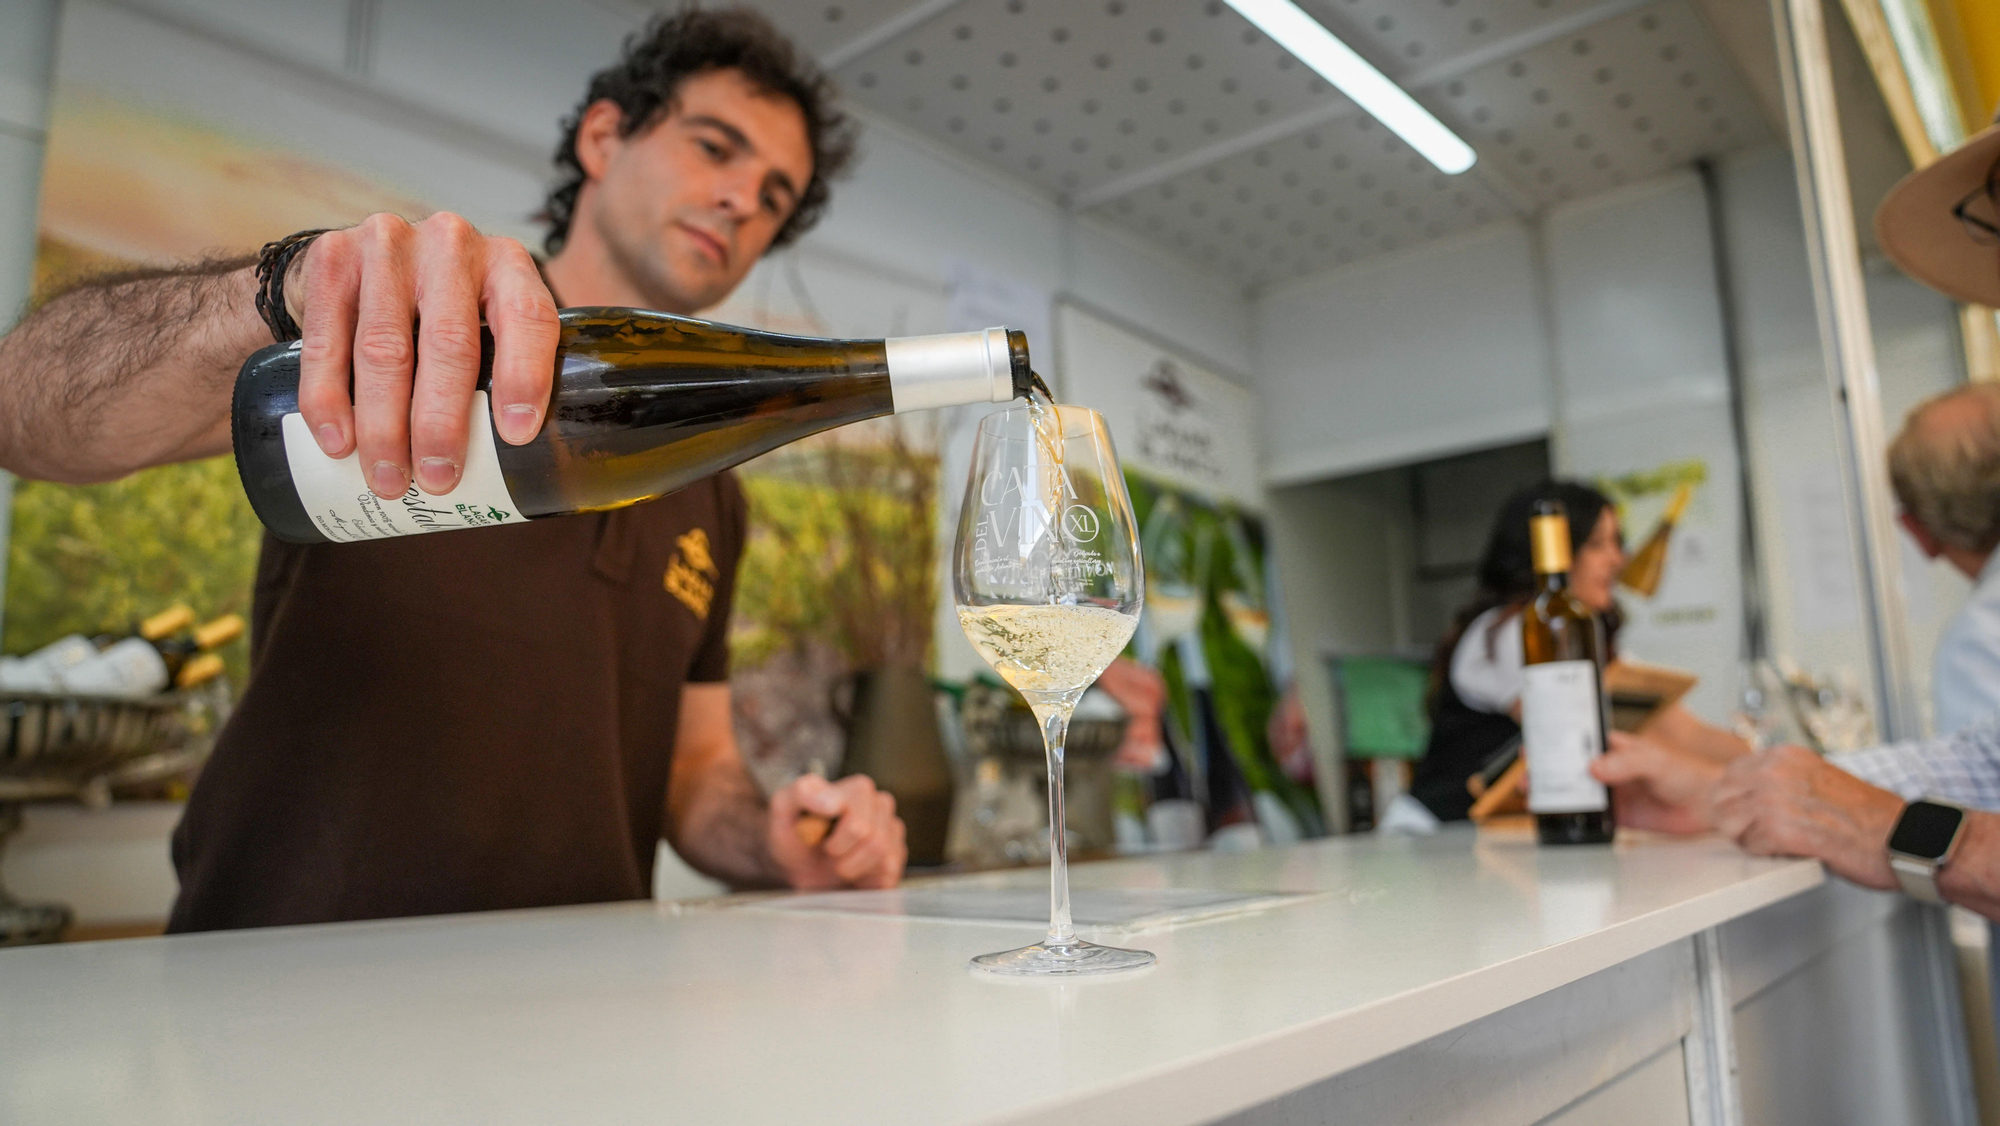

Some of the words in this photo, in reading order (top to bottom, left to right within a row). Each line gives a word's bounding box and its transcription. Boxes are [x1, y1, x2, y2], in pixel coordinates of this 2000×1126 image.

[981, 463, 1079, 507] CATA
[975, 514, 990, 552] DEL
[988, 504, 1100, 548] VINO
[1069, 514, 1096, 533] XL
